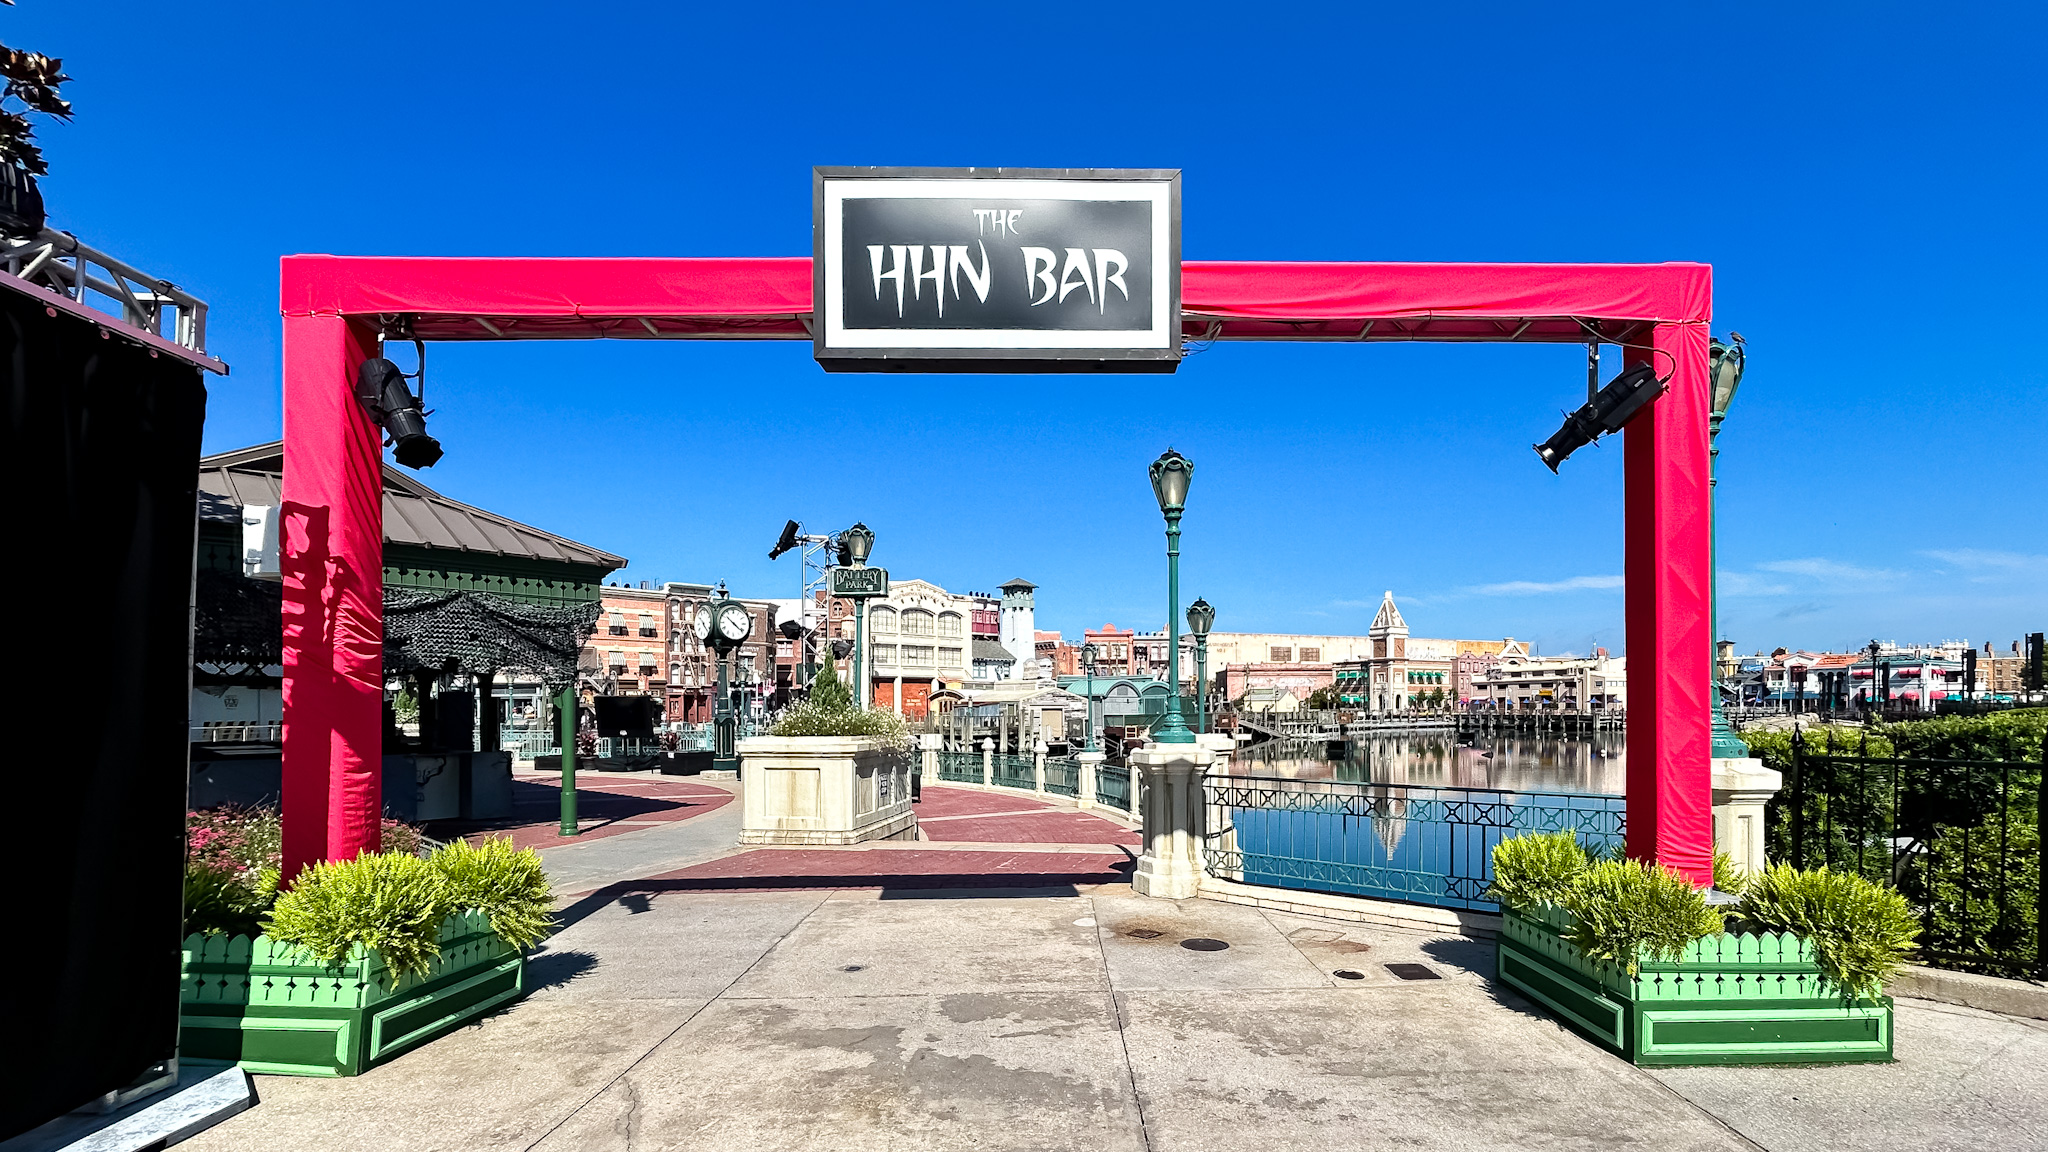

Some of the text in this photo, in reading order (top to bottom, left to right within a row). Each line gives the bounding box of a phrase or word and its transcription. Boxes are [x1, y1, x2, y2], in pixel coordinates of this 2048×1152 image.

[972, 208, 1024, 239] THE
[866, 238, 1130, 319] HHN BAR
[836, 570, 879, 586] BATTERY
[845, 580, 869, 589] PARK
